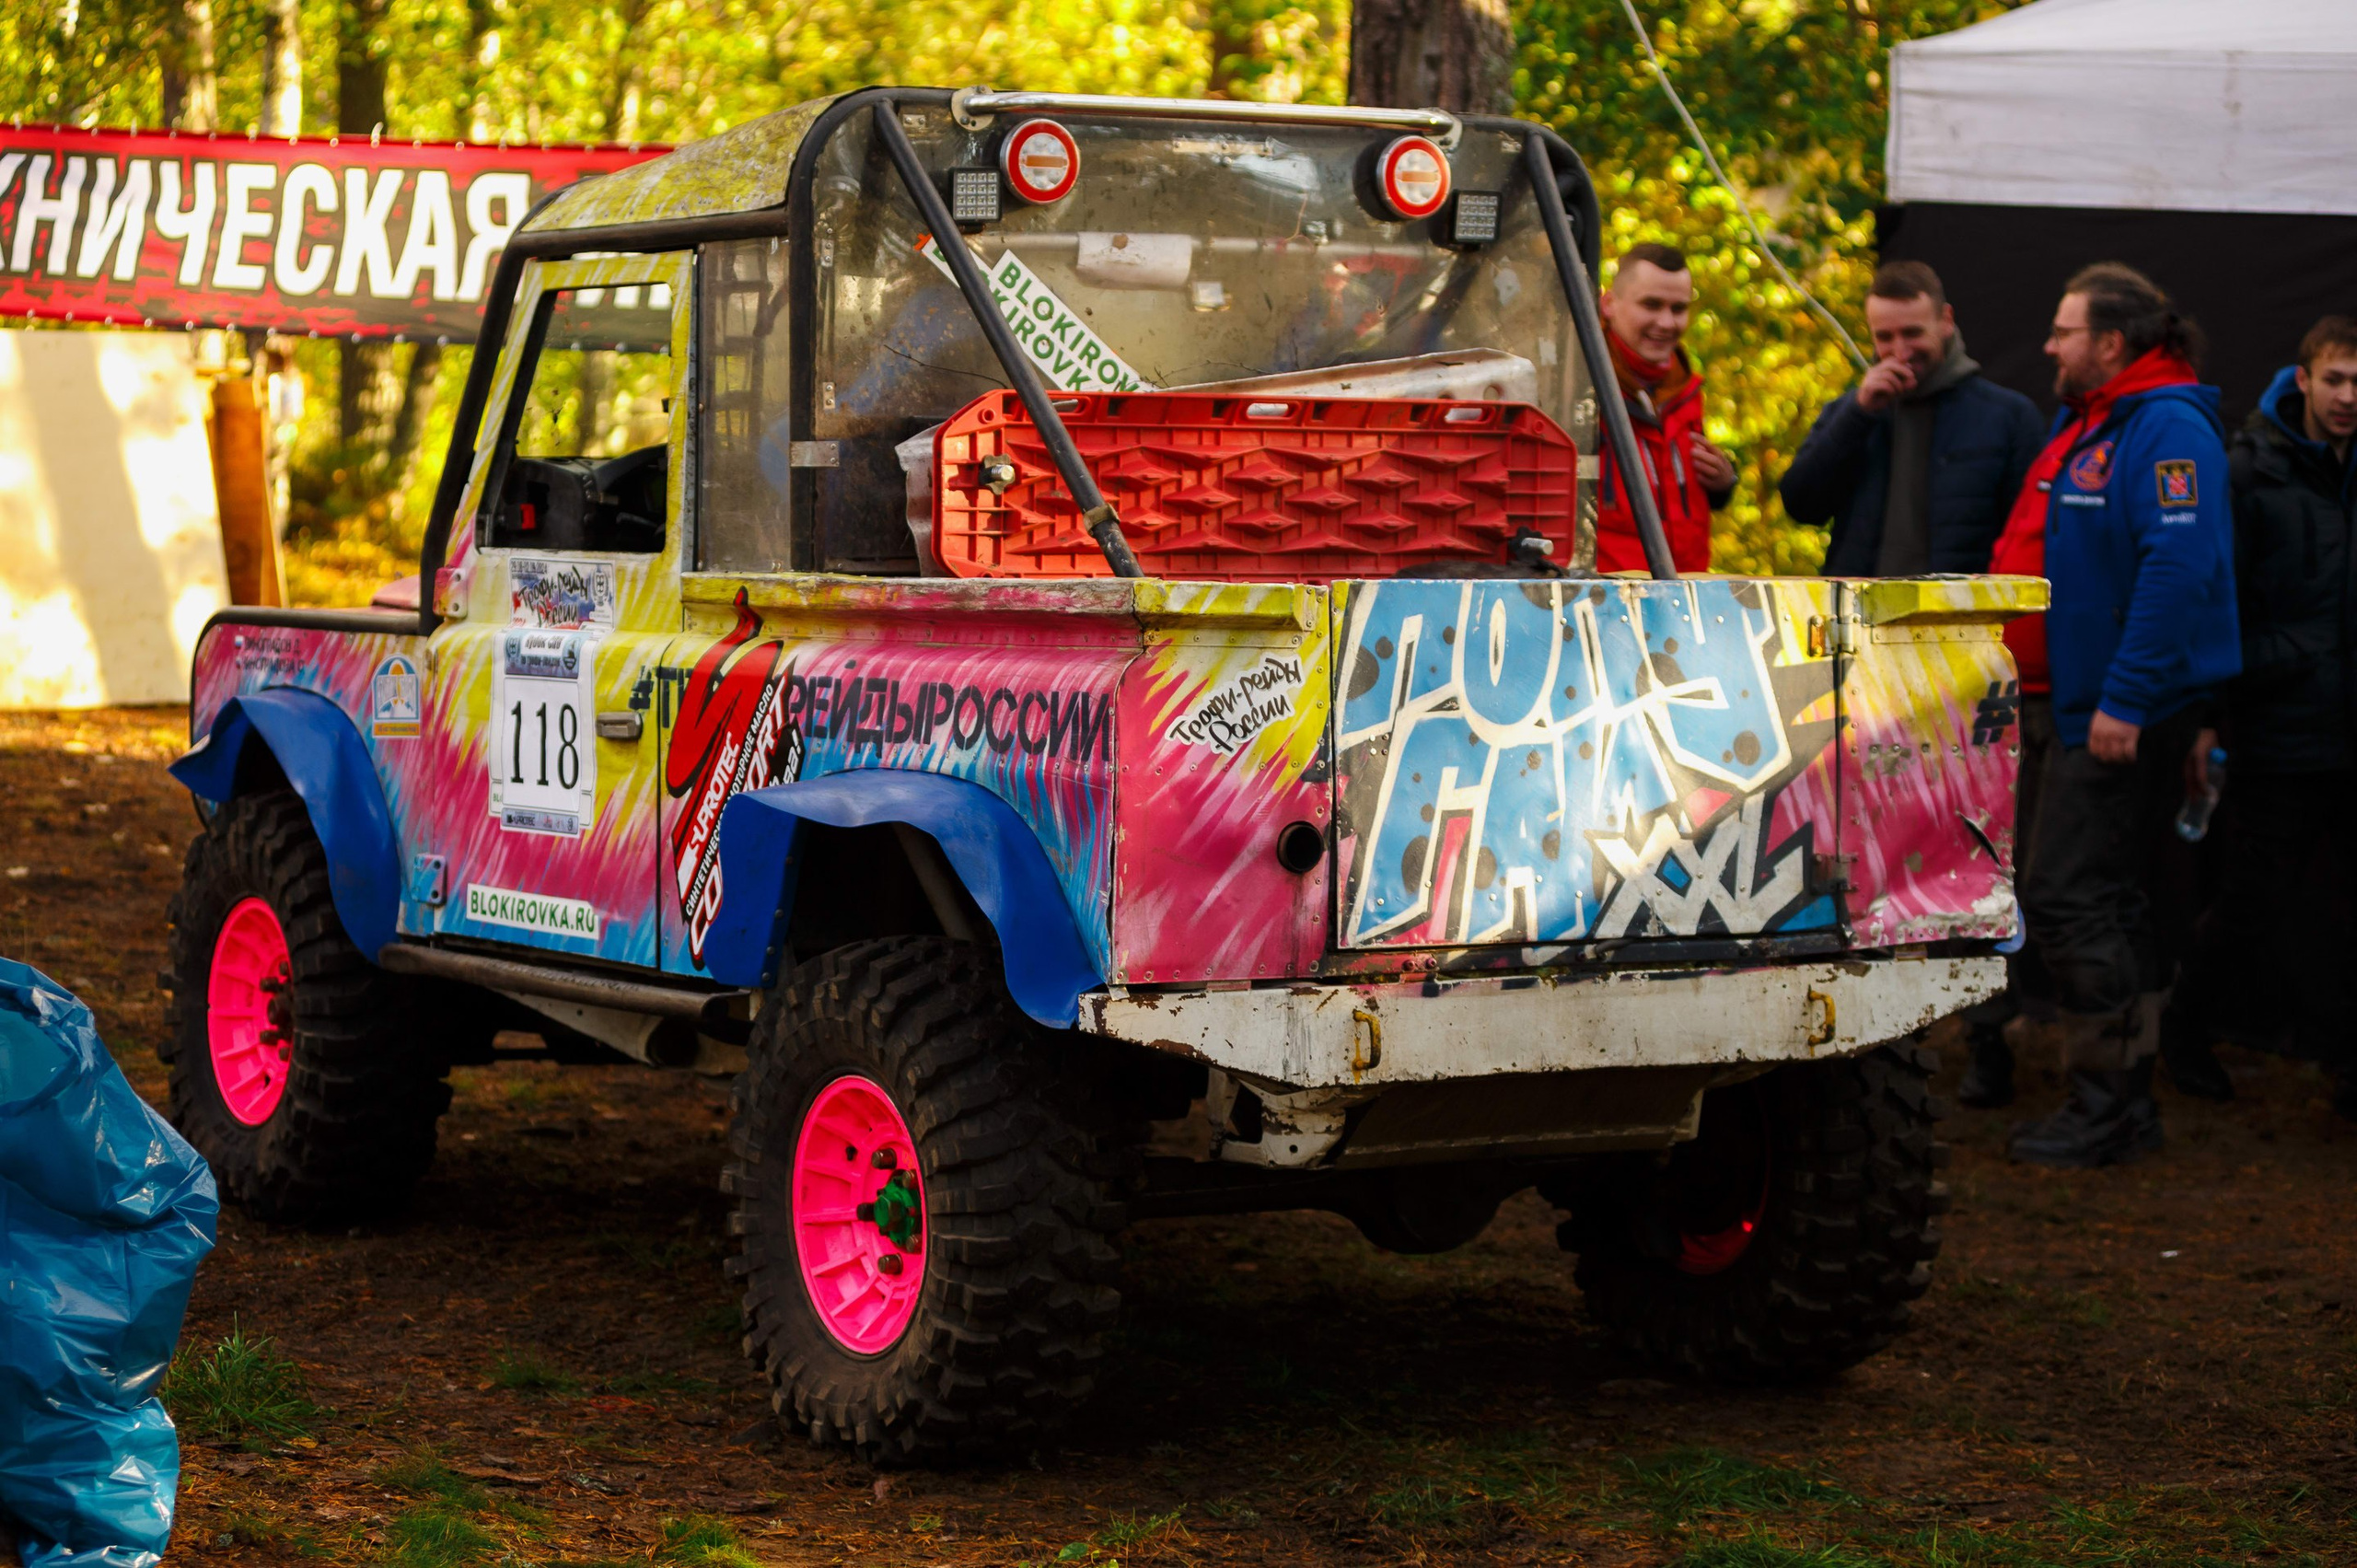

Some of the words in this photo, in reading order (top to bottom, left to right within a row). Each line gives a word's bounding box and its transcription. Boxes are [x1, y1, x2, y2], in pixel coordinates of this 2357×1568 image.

[750, 683, 773, 735] МАСЛО
[1169, 657, 1302, 742] Трофи-рейды
[1208, 694, 1291, 752] России
[511, 701, 579, 790] 118
[470, 889, 595, 933] BLOKIROVKA.RU
